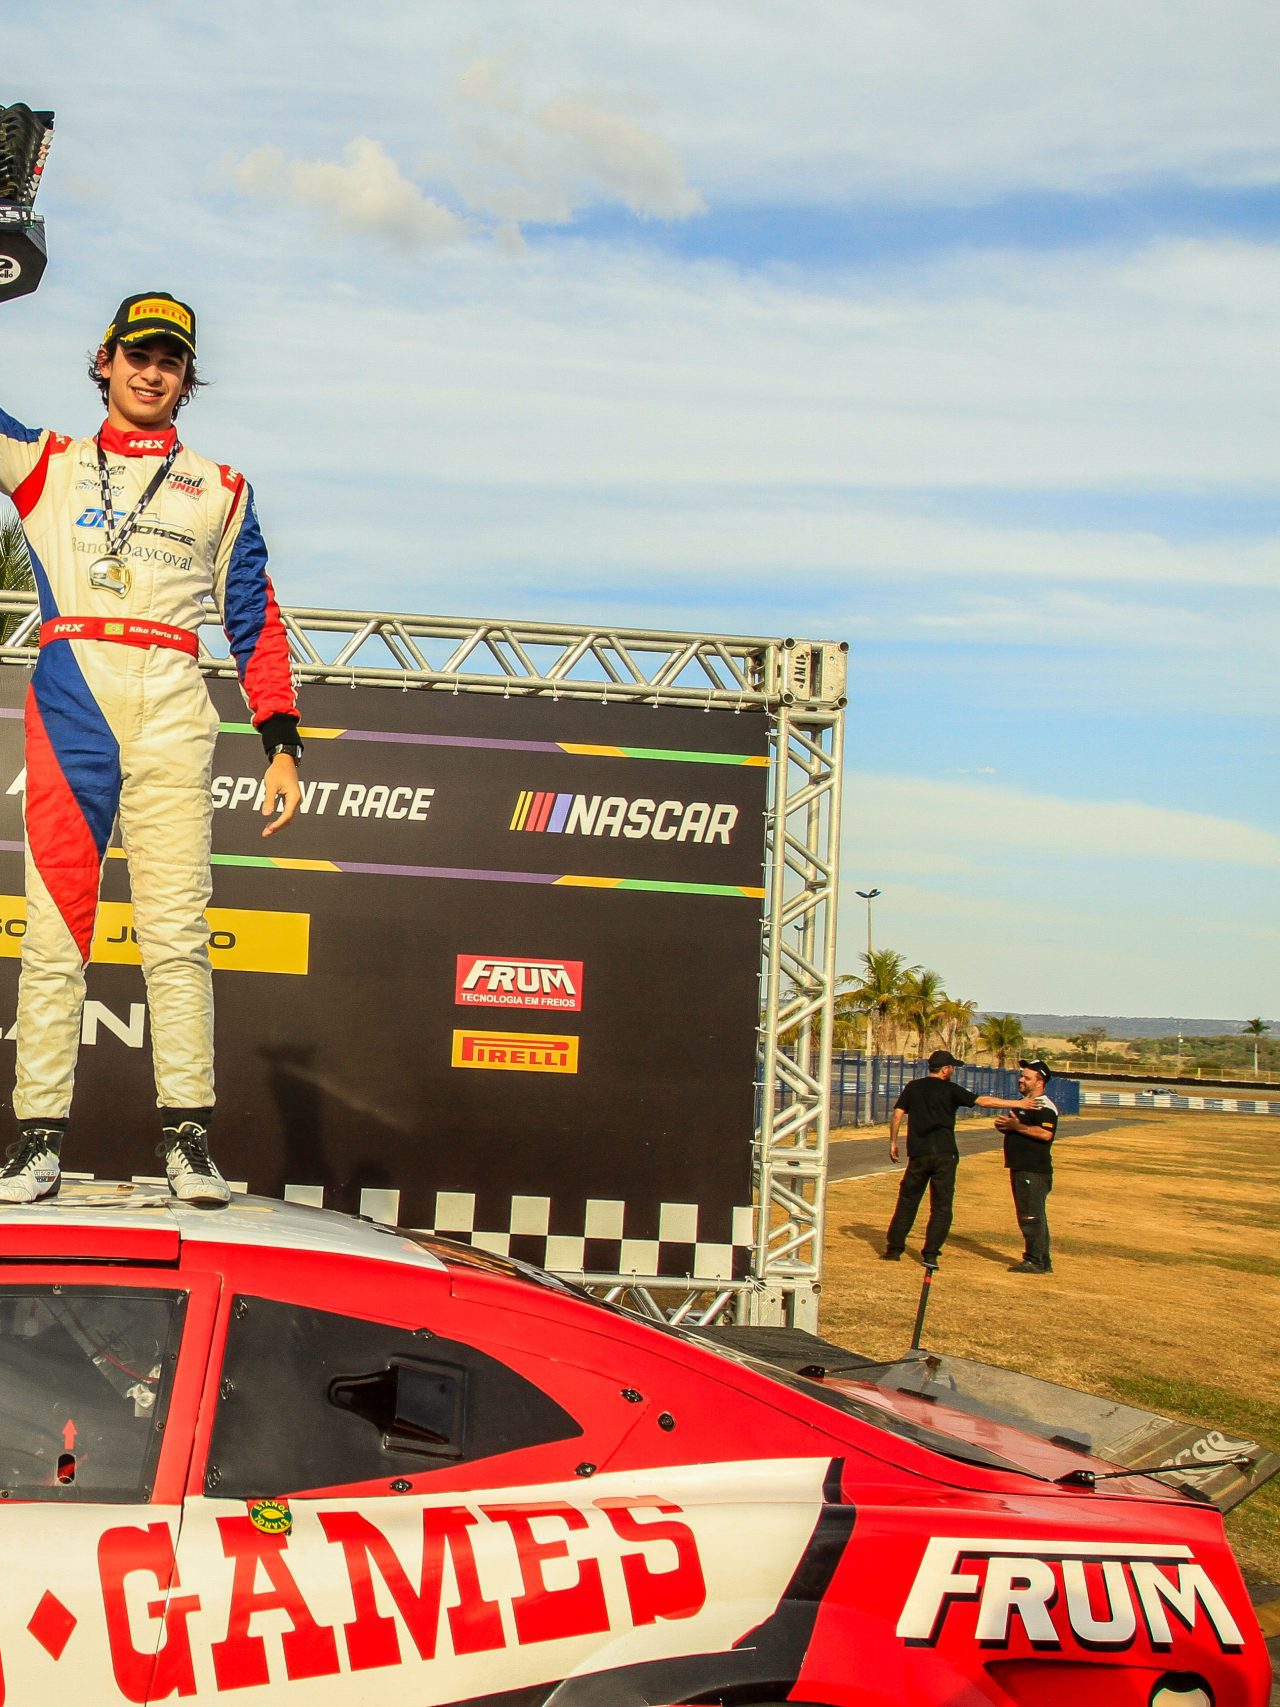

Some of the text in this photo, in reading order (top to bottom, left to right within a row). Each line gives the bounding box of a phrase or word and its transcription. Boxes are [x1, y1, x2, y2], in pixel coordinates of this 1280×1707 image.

[134, 304, 189, 325] PIRELLI
[129, 440, 165, 449] HRX
[167, 473, 204, 488] road
[171, 482, 204, 496] INDY
[54, 623, 84, 633] HRX
[338, 783, 435, 821] RACE
[565, 794, 739, 845] NASCAR
[462, 960, 577, 995] FRUM
[461, 993, 576, 1008] TECNOLOGIA EM FREIOS
[462, 1037, 569, 1067] PIRELLI
[254, 1501, 289, 1514] ETANOL
[96, 1495, 708, 1703] GAMES
[895, 1536, 1246, 1650] FRUM
